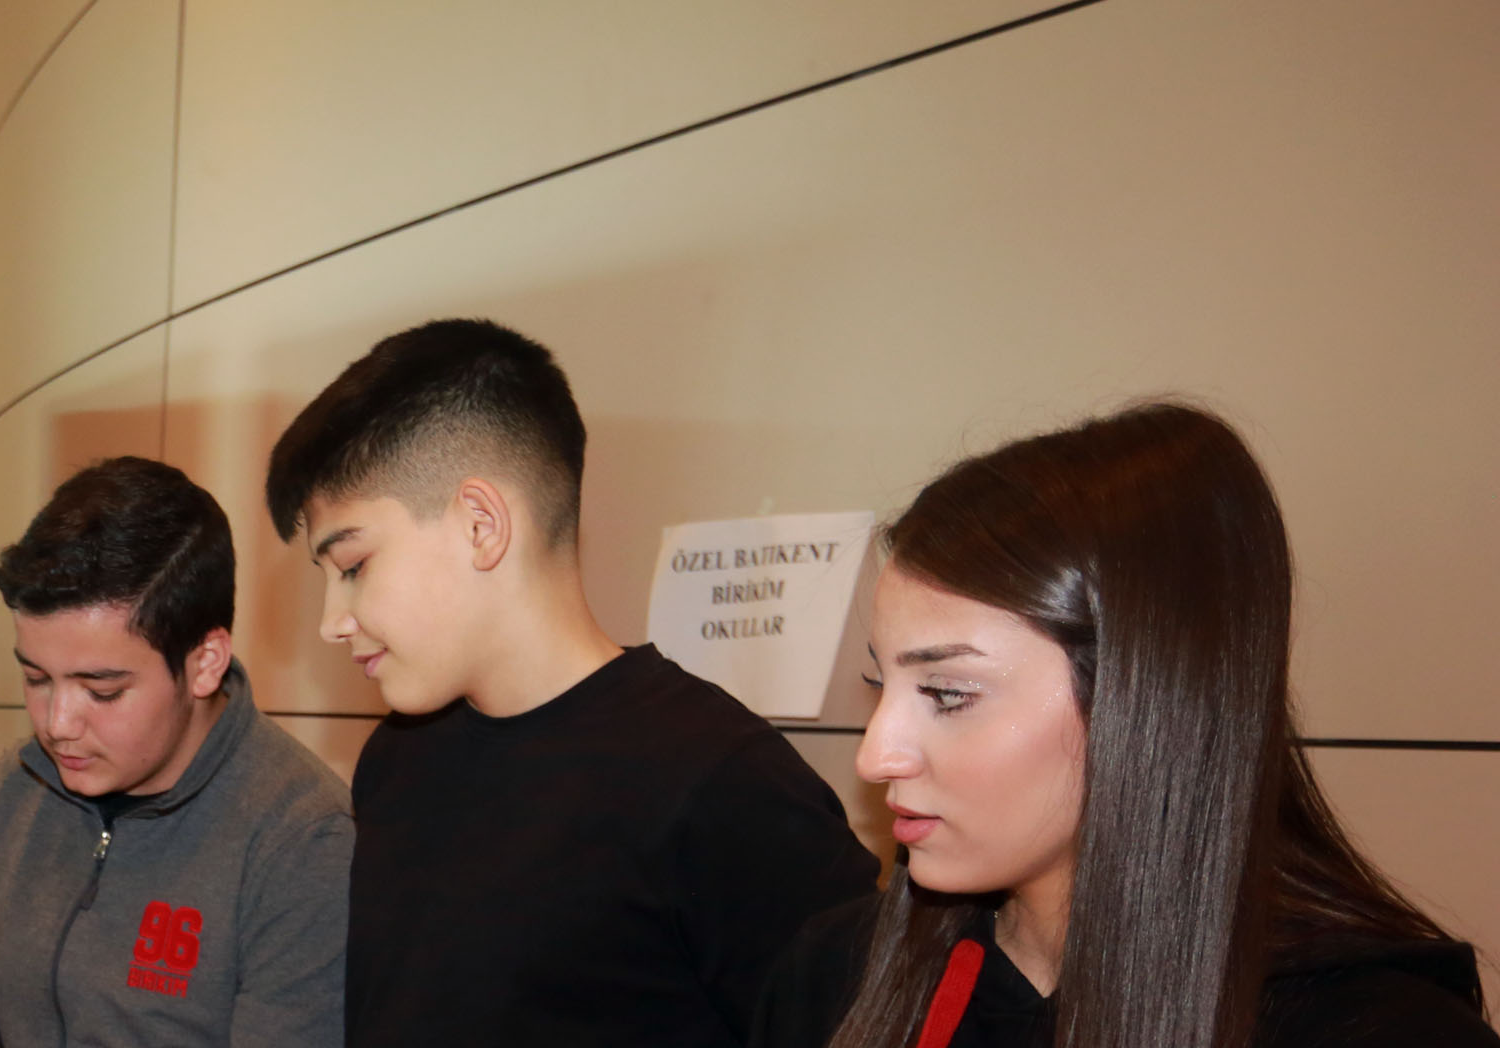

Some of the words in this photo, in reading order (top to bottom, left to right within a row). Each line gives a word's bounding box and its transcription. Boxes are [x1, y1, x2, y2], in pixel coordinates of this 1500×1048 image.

[671, 547, 729, 574] ÖZEL
[733, 541, 841, 569] BATIKENT
[711, 576, 785, 605] BİRİKİM
[700, 615, 785, 641] OKULLAR
[133, 899, 204, 972] 96
